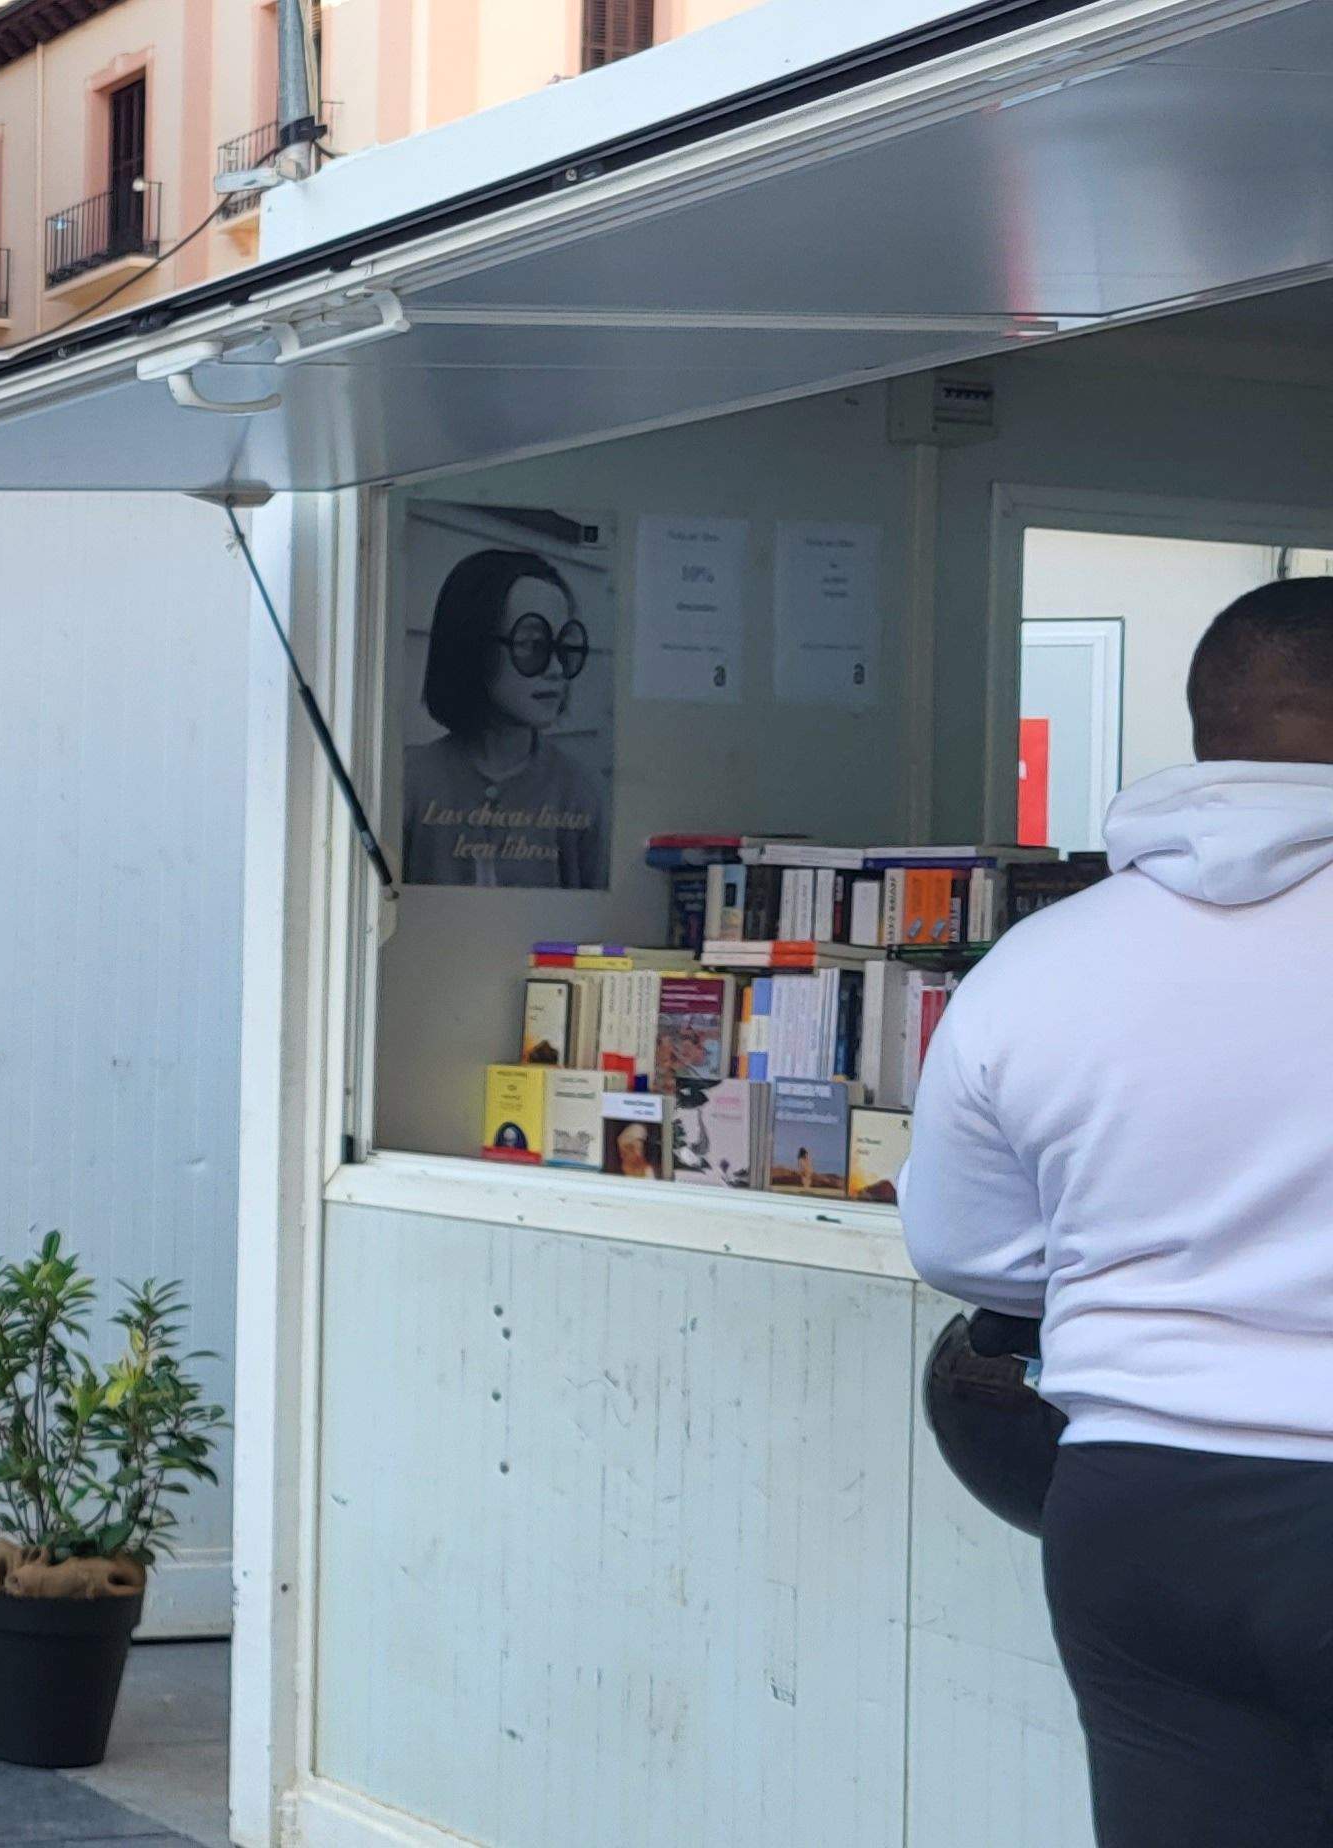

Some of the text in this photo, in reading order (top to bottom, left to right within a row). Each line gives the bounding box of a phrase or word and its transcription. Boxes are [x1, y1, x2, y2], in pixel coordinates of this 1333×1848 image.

[467, 800, 535, 828] chicas
[452, 833, 559, 861] leen libros
